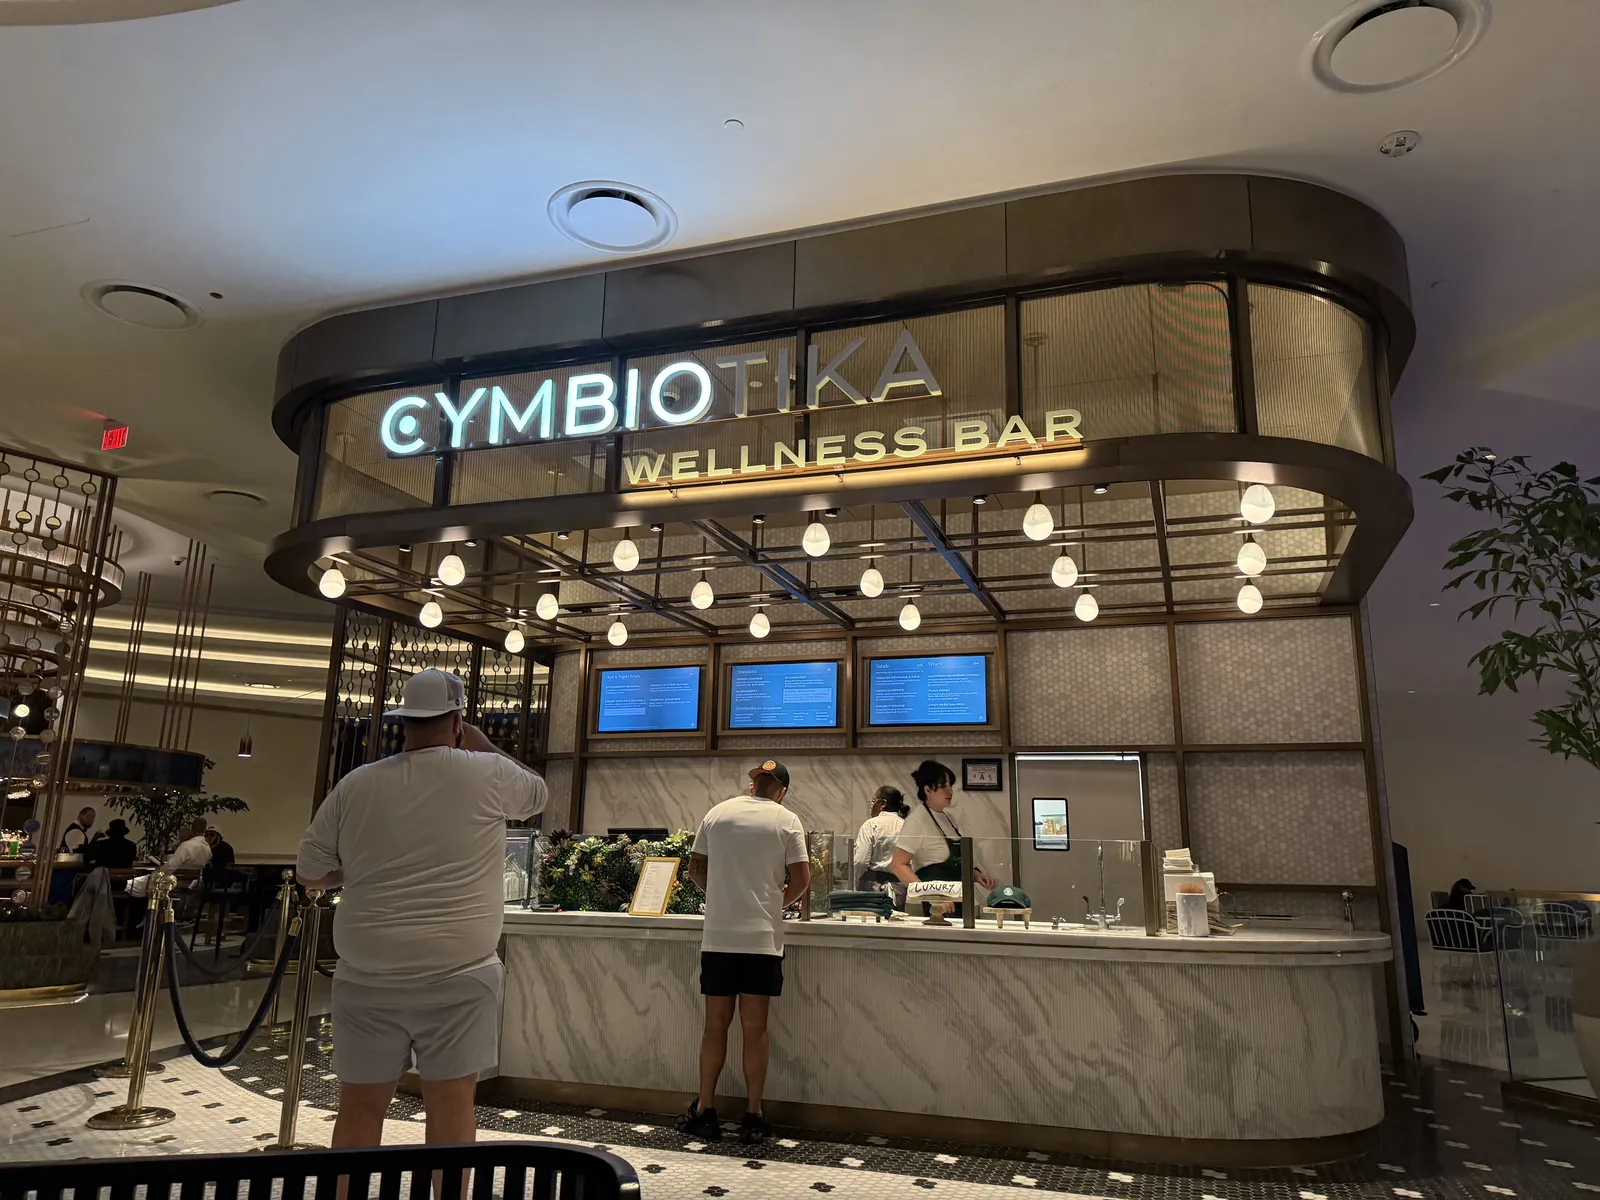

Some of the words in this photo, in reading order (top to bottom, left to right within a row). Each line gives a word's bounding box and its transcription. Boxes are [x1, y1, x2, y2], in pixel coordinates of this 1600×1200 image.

[379, 329, 944, 456] CYMBIOTIKA
[106, 428, 126, 448] EXIT
[622, 425, 930, 486] WELLNESS
[953, 408, 1084, 453] BAR
[914, 883, 955, 893] LUXURY
